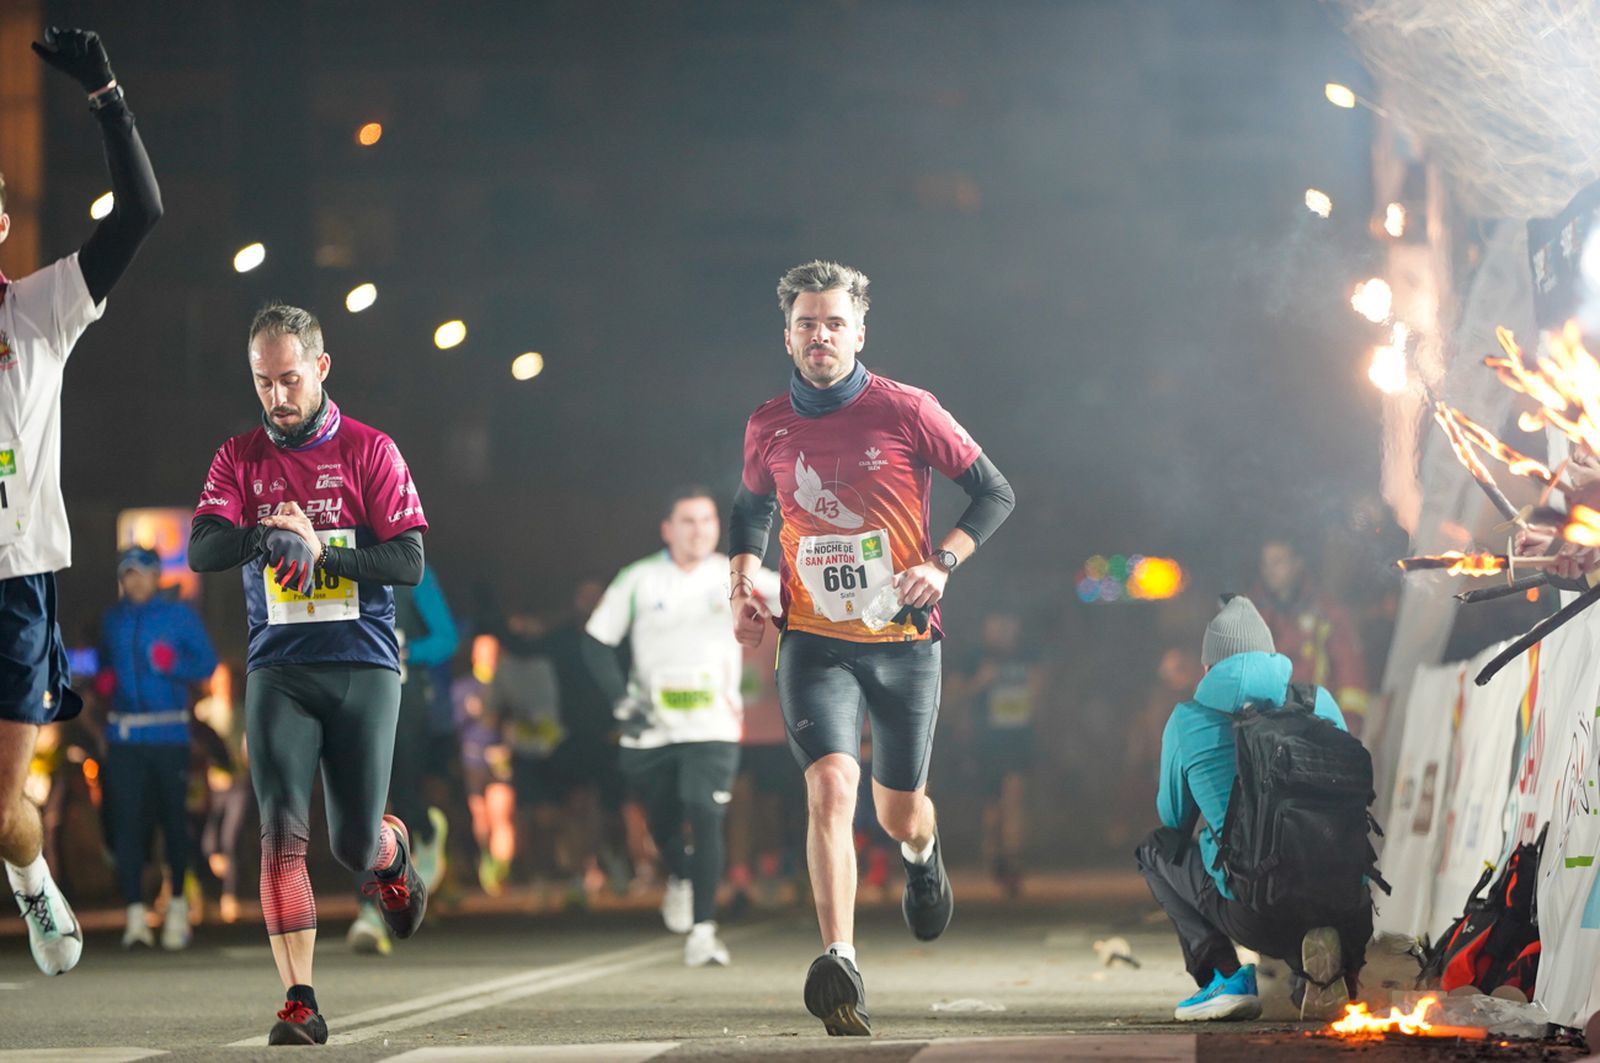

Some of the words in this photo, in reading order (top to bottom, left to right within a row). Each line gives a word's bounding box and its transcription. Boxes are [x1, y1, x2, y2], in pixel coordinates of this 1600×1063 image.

[814, 497, 840, 518] 43
[814, 544, 842, 555] NOCHE
[843, 544, 854, 553] DE
[805, 556, 823, 566] SAN
[823, 564, 868, 592] 661
